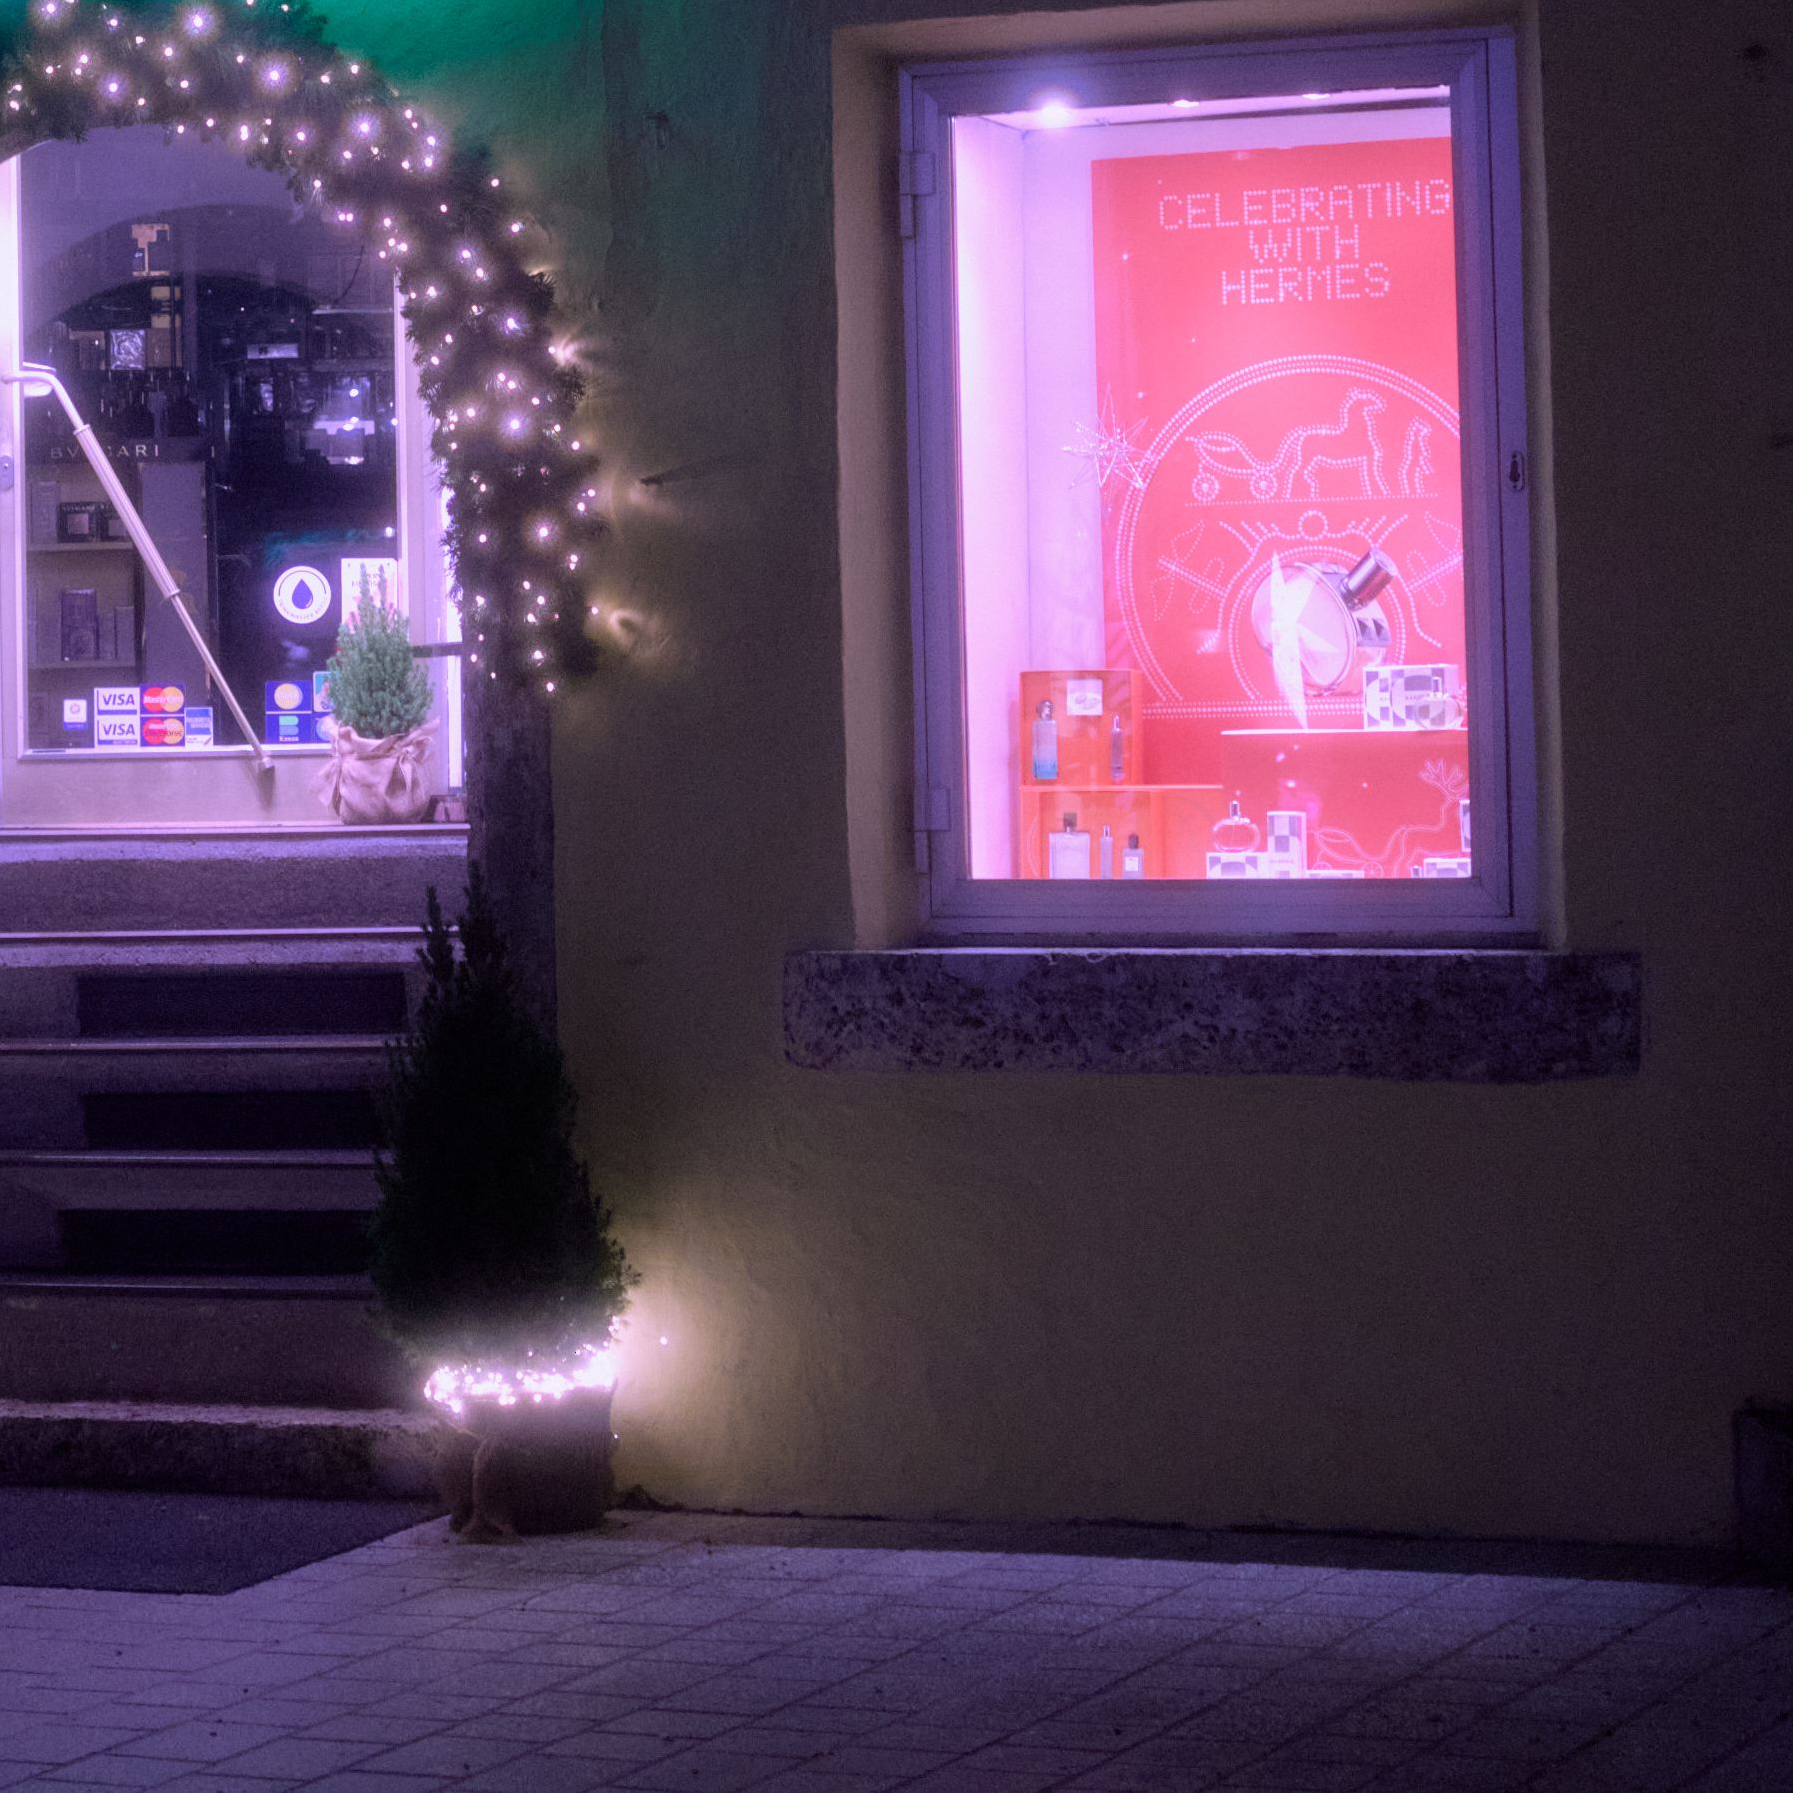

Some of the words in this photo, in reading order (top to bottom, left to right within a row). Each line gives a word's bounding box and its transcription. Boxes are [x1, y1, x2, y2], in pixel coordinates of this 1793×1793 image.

[1159, 178, 1450, 230] CELEBRATING
[1249, 223, 1359, 264] WITH
[1221, 261, 1389, 305] HERMES
[50, 444, 159, 458] BVARI
[102, 693, 135, 706] VISA
[102, 723, 136, 736] VISA
